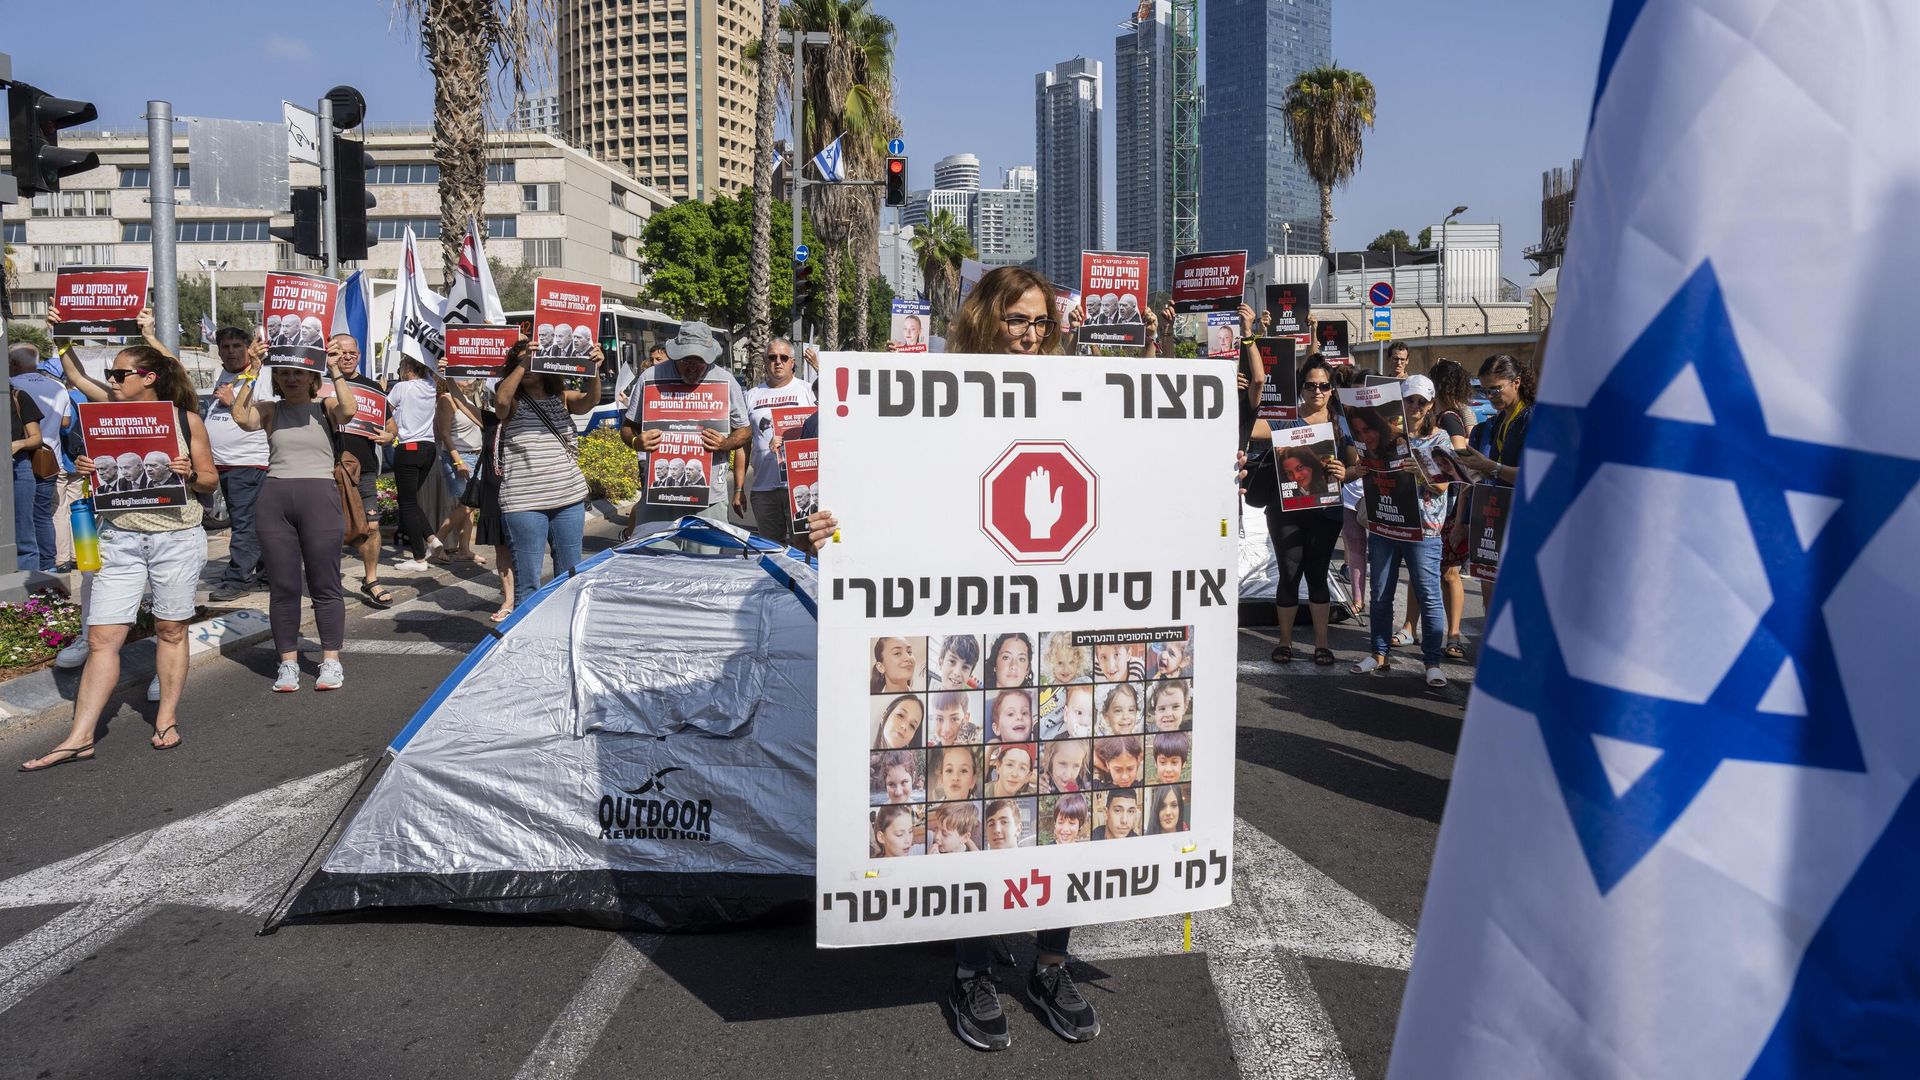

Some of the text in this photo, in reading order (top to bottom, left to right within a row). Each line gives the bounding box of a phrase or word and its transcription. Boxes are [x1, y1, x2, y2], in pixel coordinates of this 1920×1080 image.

[1091, 264, 1139, 278] החיים שלהם
[1184, 266, 1230, 278] אין הפסקת אש
[1090, 278, 1139, 290] בידיים שלכם
[1204, 277, 1224, 286] החזרת
[1226, 275, 1239, 284] ללא
[72, 284, 128, 296] אין הפסקת אש
[274, 286, 327, 302] החיים שלהם
[60, 294, 138, 306] ללא החזרת החטופים!
[550, 292, 590, 304] אין הפסקת אש
[272, 298, 326, 314] בידיים שלכם
[568, 302, 585, 310] החזרת
[586, 304, 596, 312] ללא
[458, 338, 504, 347] אין הפסקת אש
[480, 347, 500, 356] החזרת
[836, 368, 1036, 418] הרמטי!
[1264, 384, 1276, 392] החז
[660, 392, 713, 402] אין הפסקת אש
[1106, 373, 1223, 420] מצור
[686, 401, 708, 410] החזרת
[710, 400, 723, 410] ללא
[99, 416, 157, 427] אין הפסקת אש
[90, 425, 169, 436] ללא החזרת החטופים!
[659, 444, 704, 456] בידיים שלכם
[798, 452, 808, 460] אש
[1282, 482, 1298, 490] BRING
[1282, 490, 1294, 498] HER
[833, 569, 1227, 620] אין סיוע הומניטרי
[1077, 630, 1182, 643] הילדים החטופים והנעדרים
[599, 795, 712, 833] OUTDOOR
[599, 828, 711, 841] REVOLUTION
[823, 850, 1227, 922] למי שהוא לא הומניטרי
